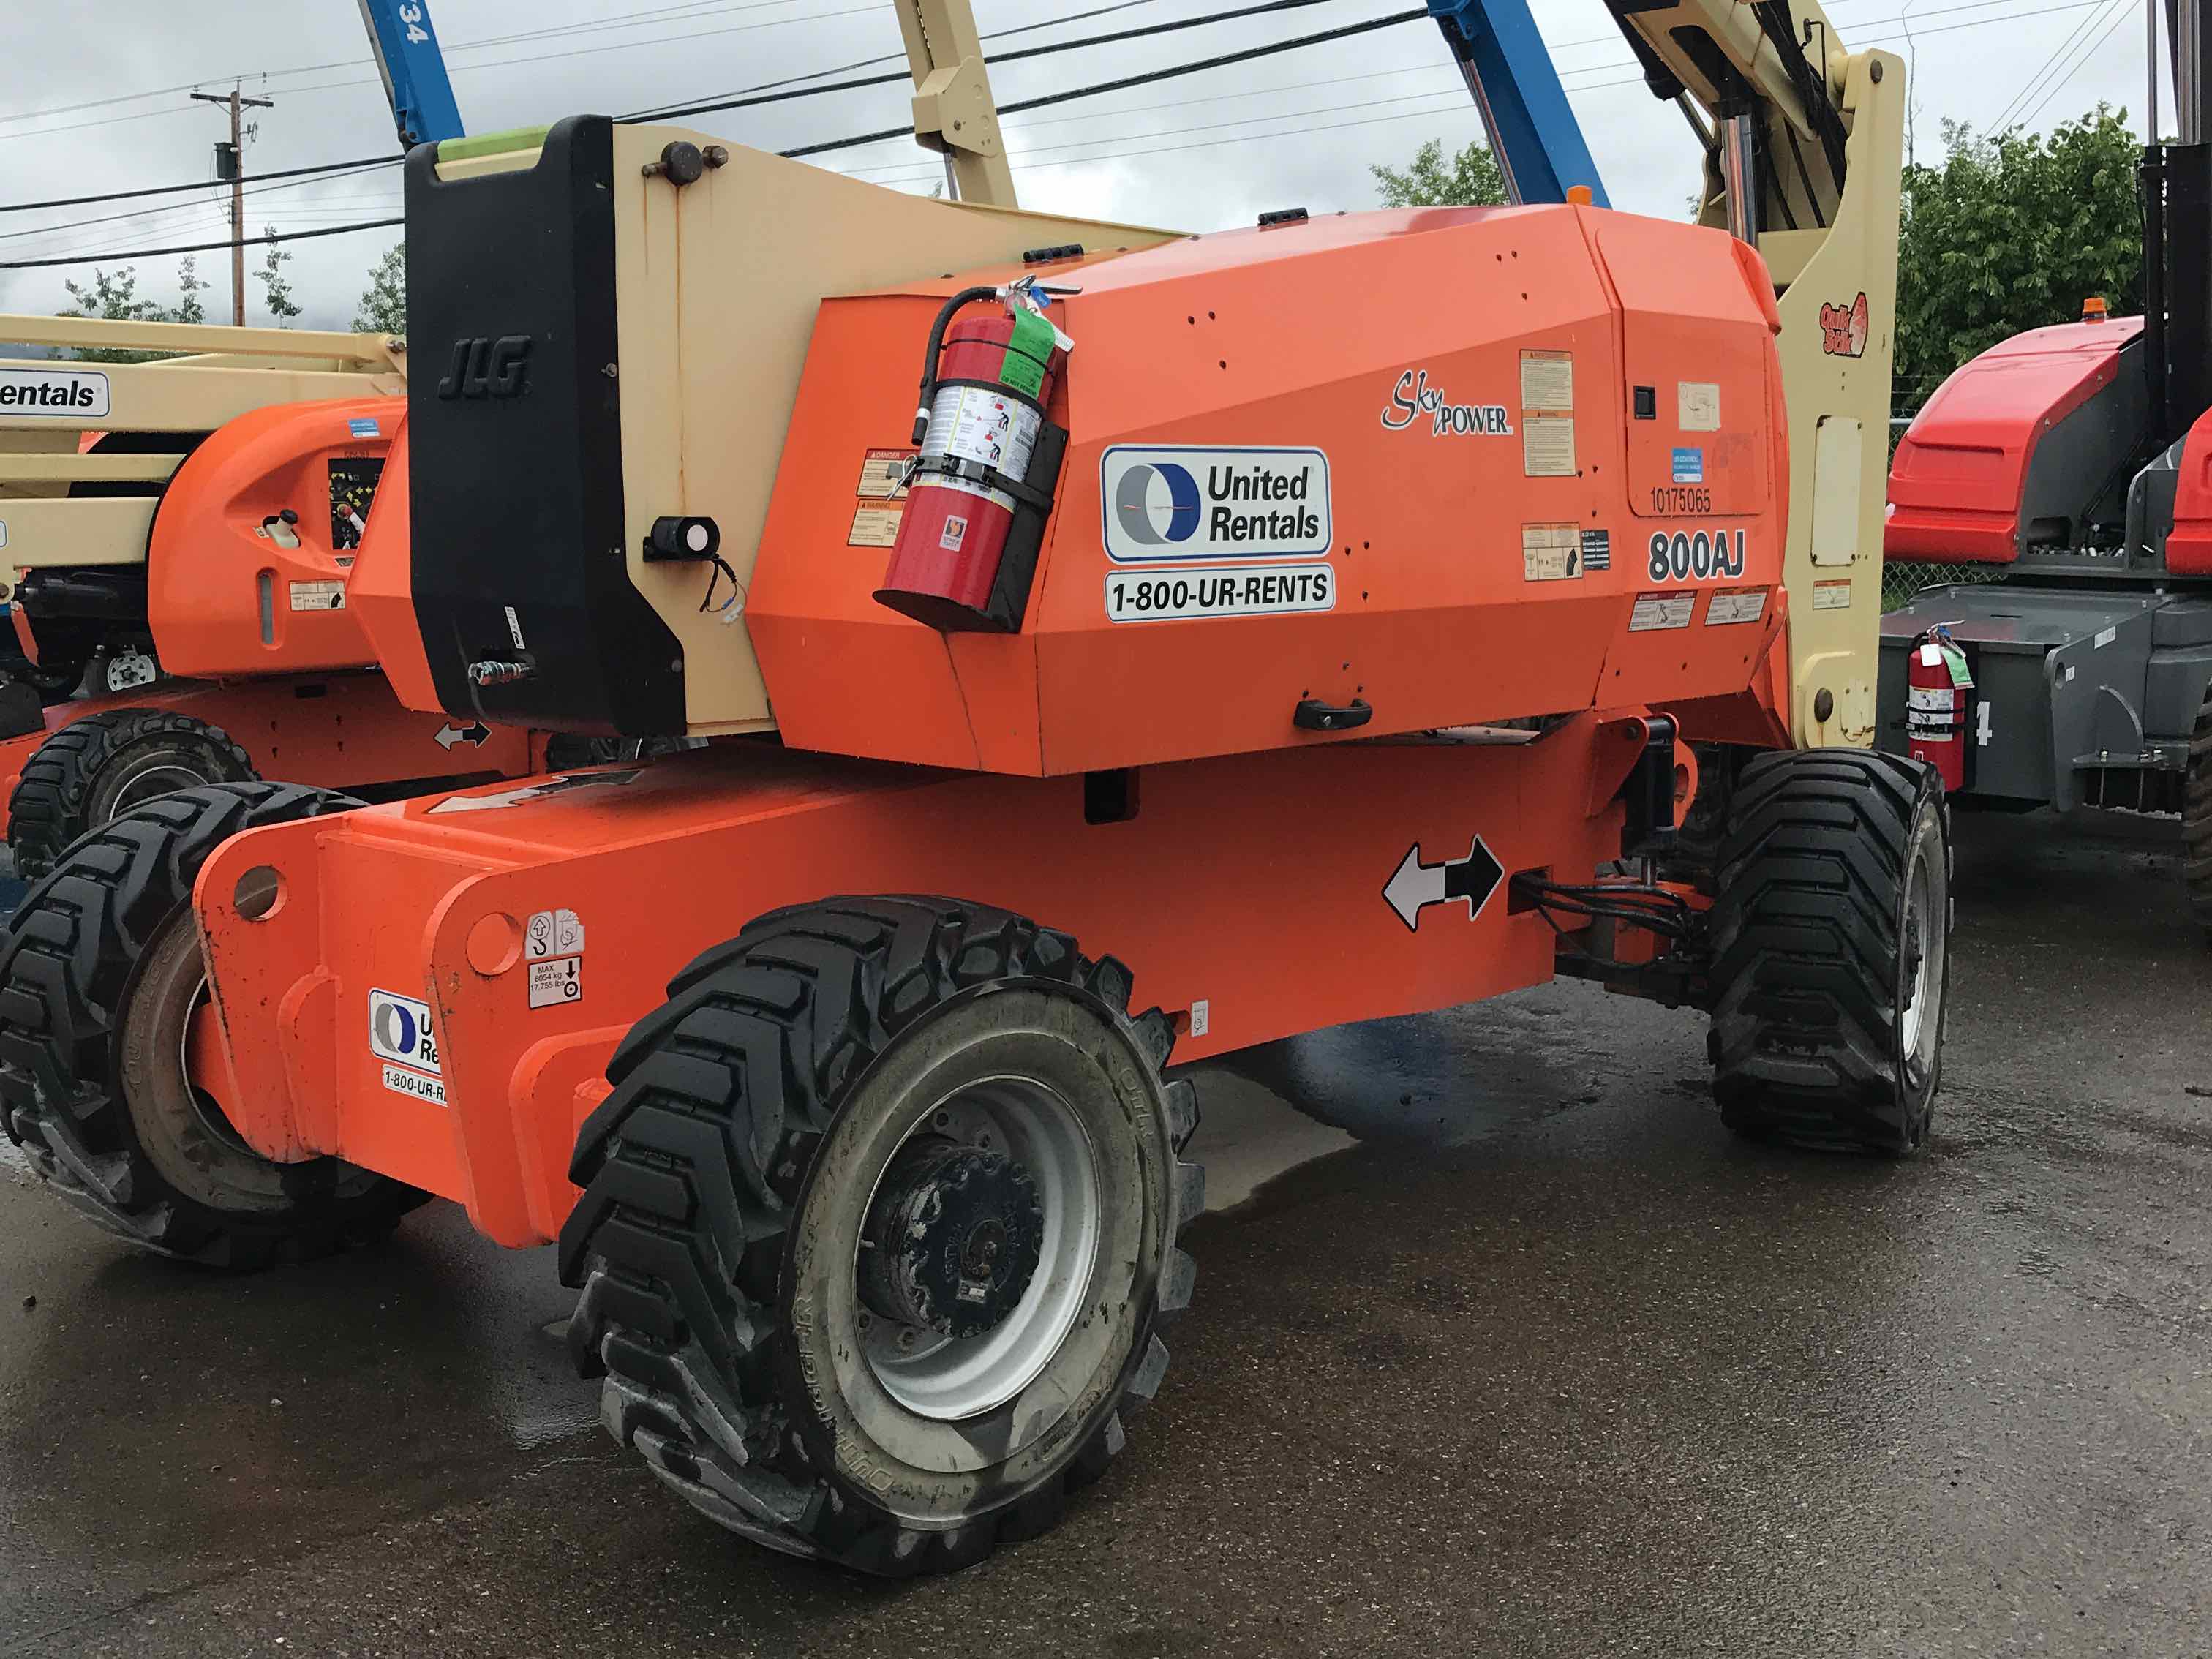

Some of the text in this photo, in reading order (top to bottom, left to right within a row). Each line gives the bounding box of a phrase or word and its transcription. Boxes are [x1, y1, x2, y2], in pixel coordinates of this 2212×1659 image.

[399, 0, 429, 44] 34
[439, 335, 530, 399] JLG
[0, 380, 94, 407] entals
[1382, 371, 1444, 435] Sky
[1440, 407, 1508, 433] POWER
[1208, 466, 1309, 501] United
[1651, 488, 1711, 513] 10175065
[1209, 505, 1320, 541] Rentals
[1649, 531, 1745, 582] 800AJ
[1113, 573, 1328, 612] 1-800-UR-RENTS
[535, 972, 563, 982] 8054 kg
[538, 965, 554, 974] MAX
[420, 1013, 433, 1036] U
[385, 1071, 448, 1102] 1-800-UR-R
